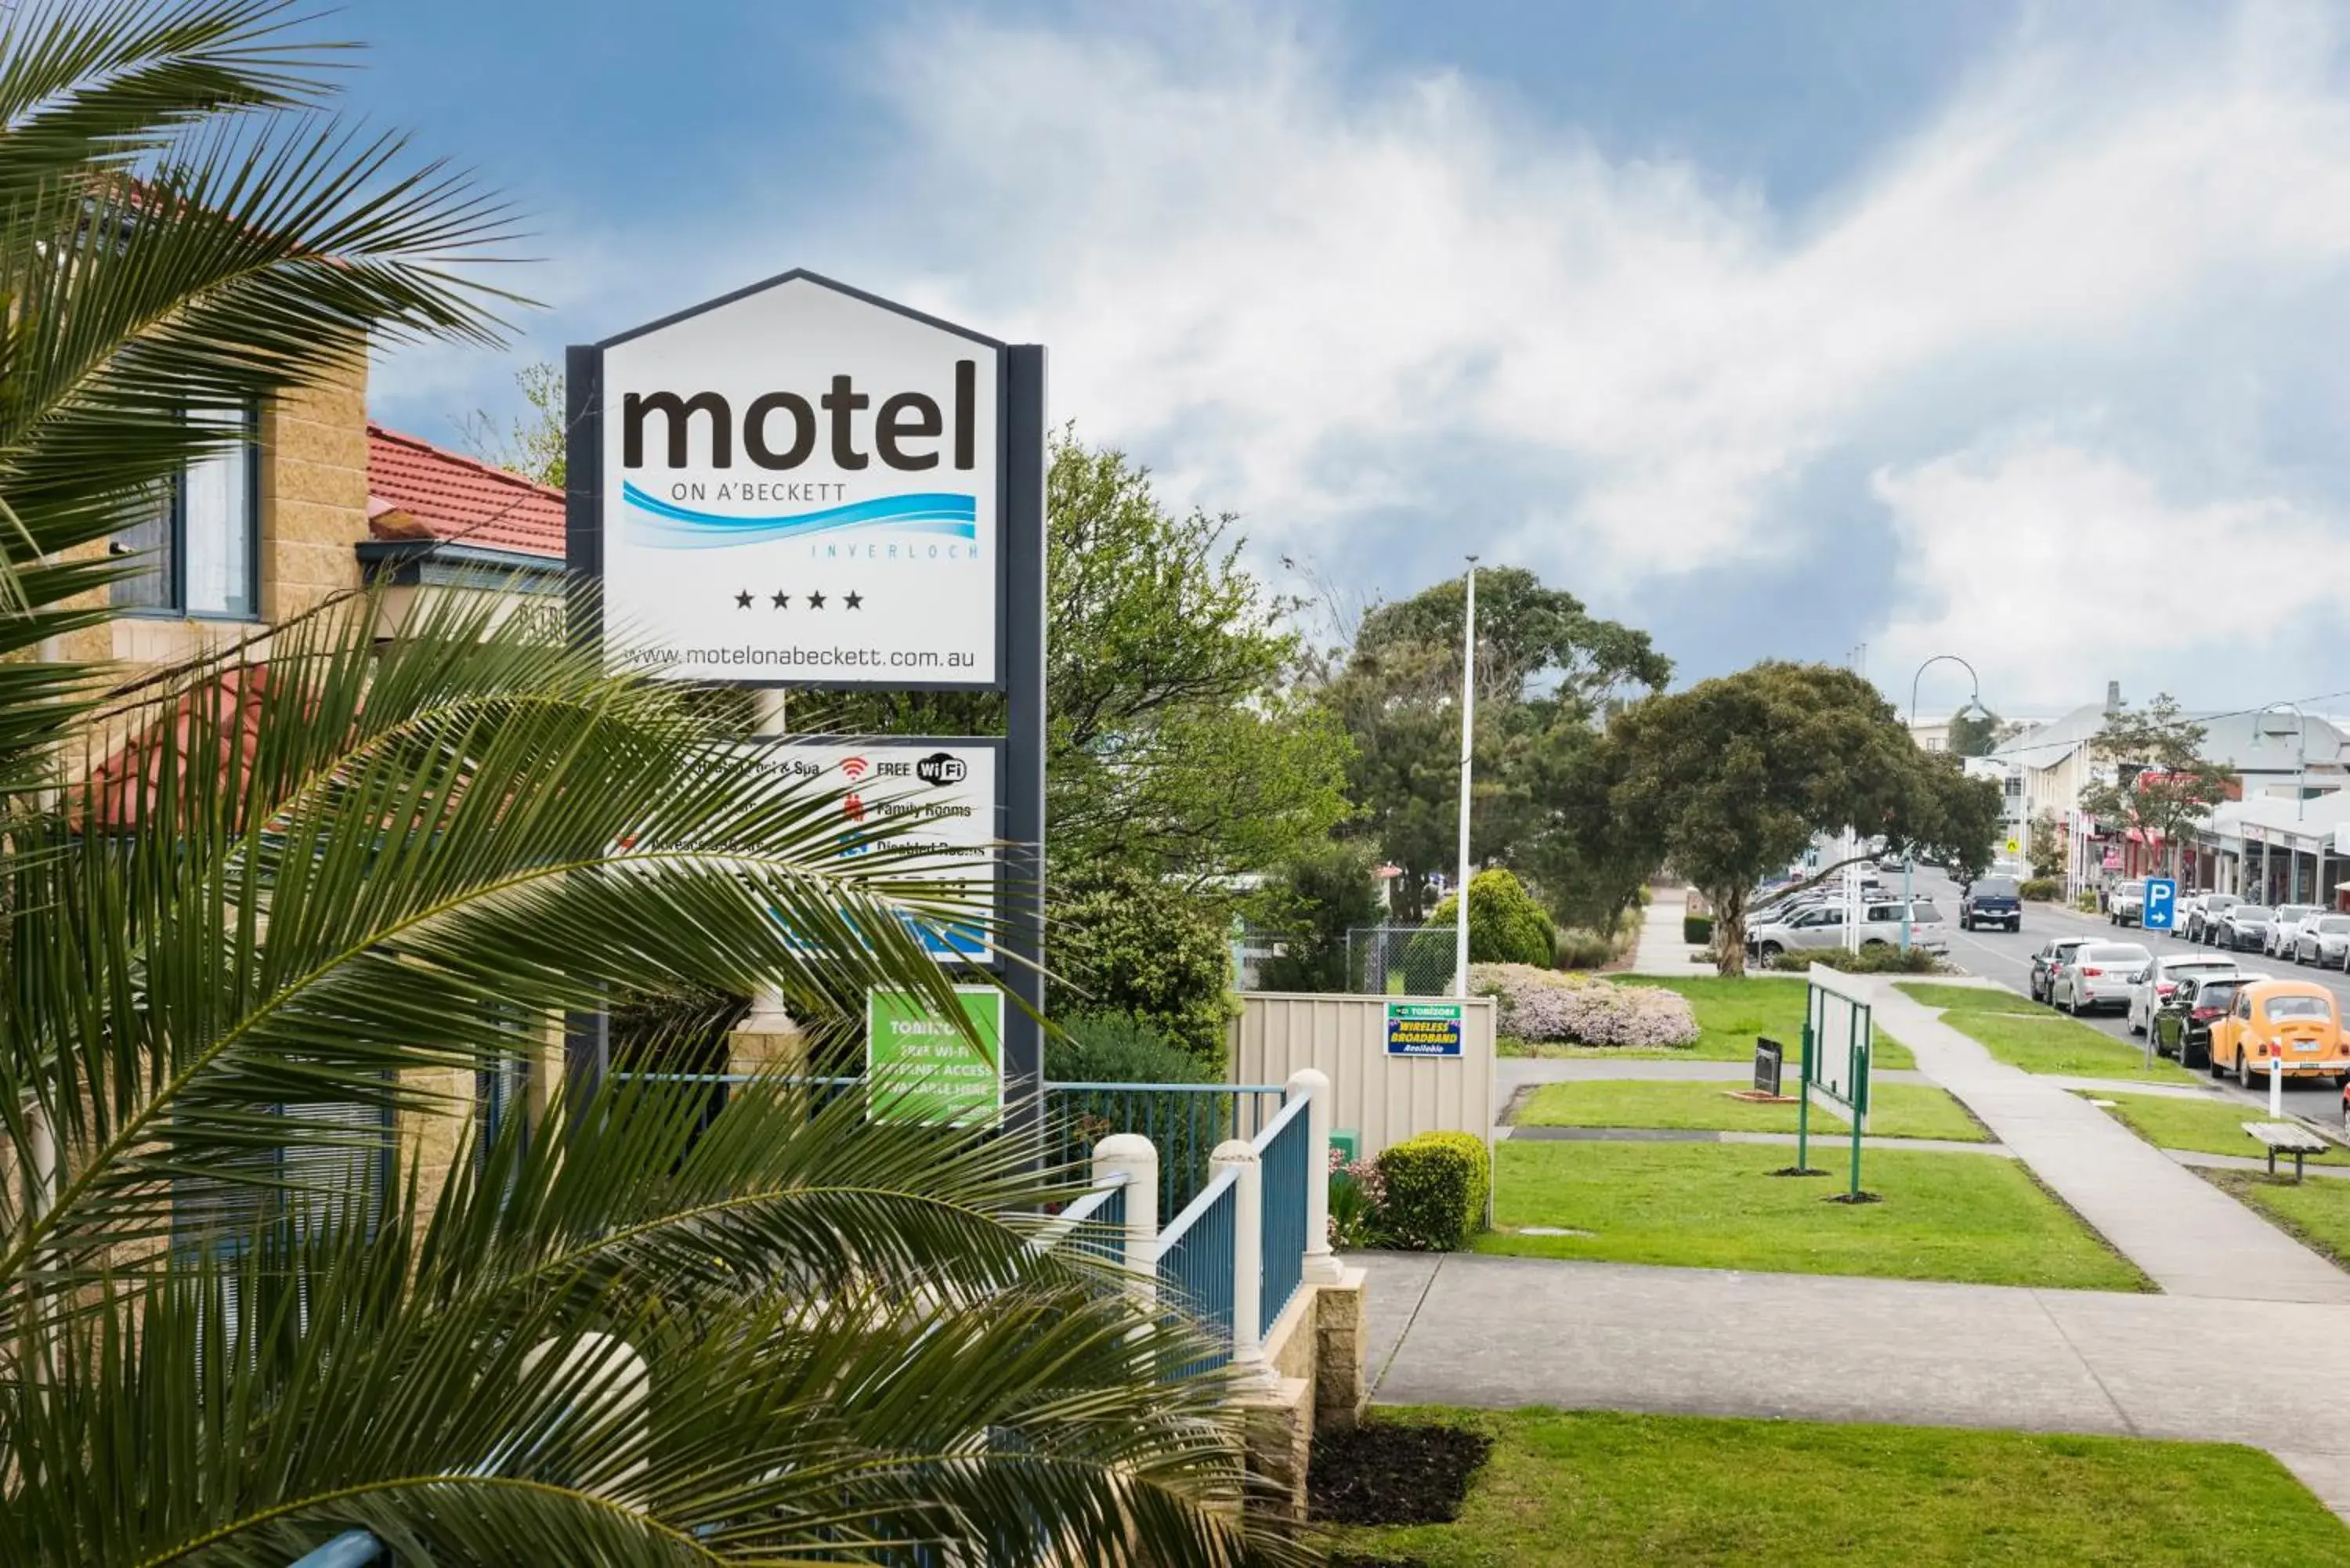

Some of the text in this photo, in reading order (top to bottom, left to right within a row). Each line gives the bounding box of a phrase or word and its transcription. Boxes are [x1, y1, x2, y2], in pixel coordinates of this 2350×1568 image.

[623, 359, 976, 471] motel
[671, 482, 847, 502] ON A'BECKETT
[812, 544, 978, 559] INVERLOCH
[624, 645, 974, 668] www.motelonabeckett.com.au
[794, 761, 820, 777] Spa
[877, 762, 912, 776] FREE
[877, 801, 971, 818] Family Rooms
[2150, 884, 2171, 908] P
[1400, 1021, 1448, 1031] WIRELESS
[1390, 1032, 1458, 1043] BROADBAND
[944, 1064, 992, 1077] ACCESS
